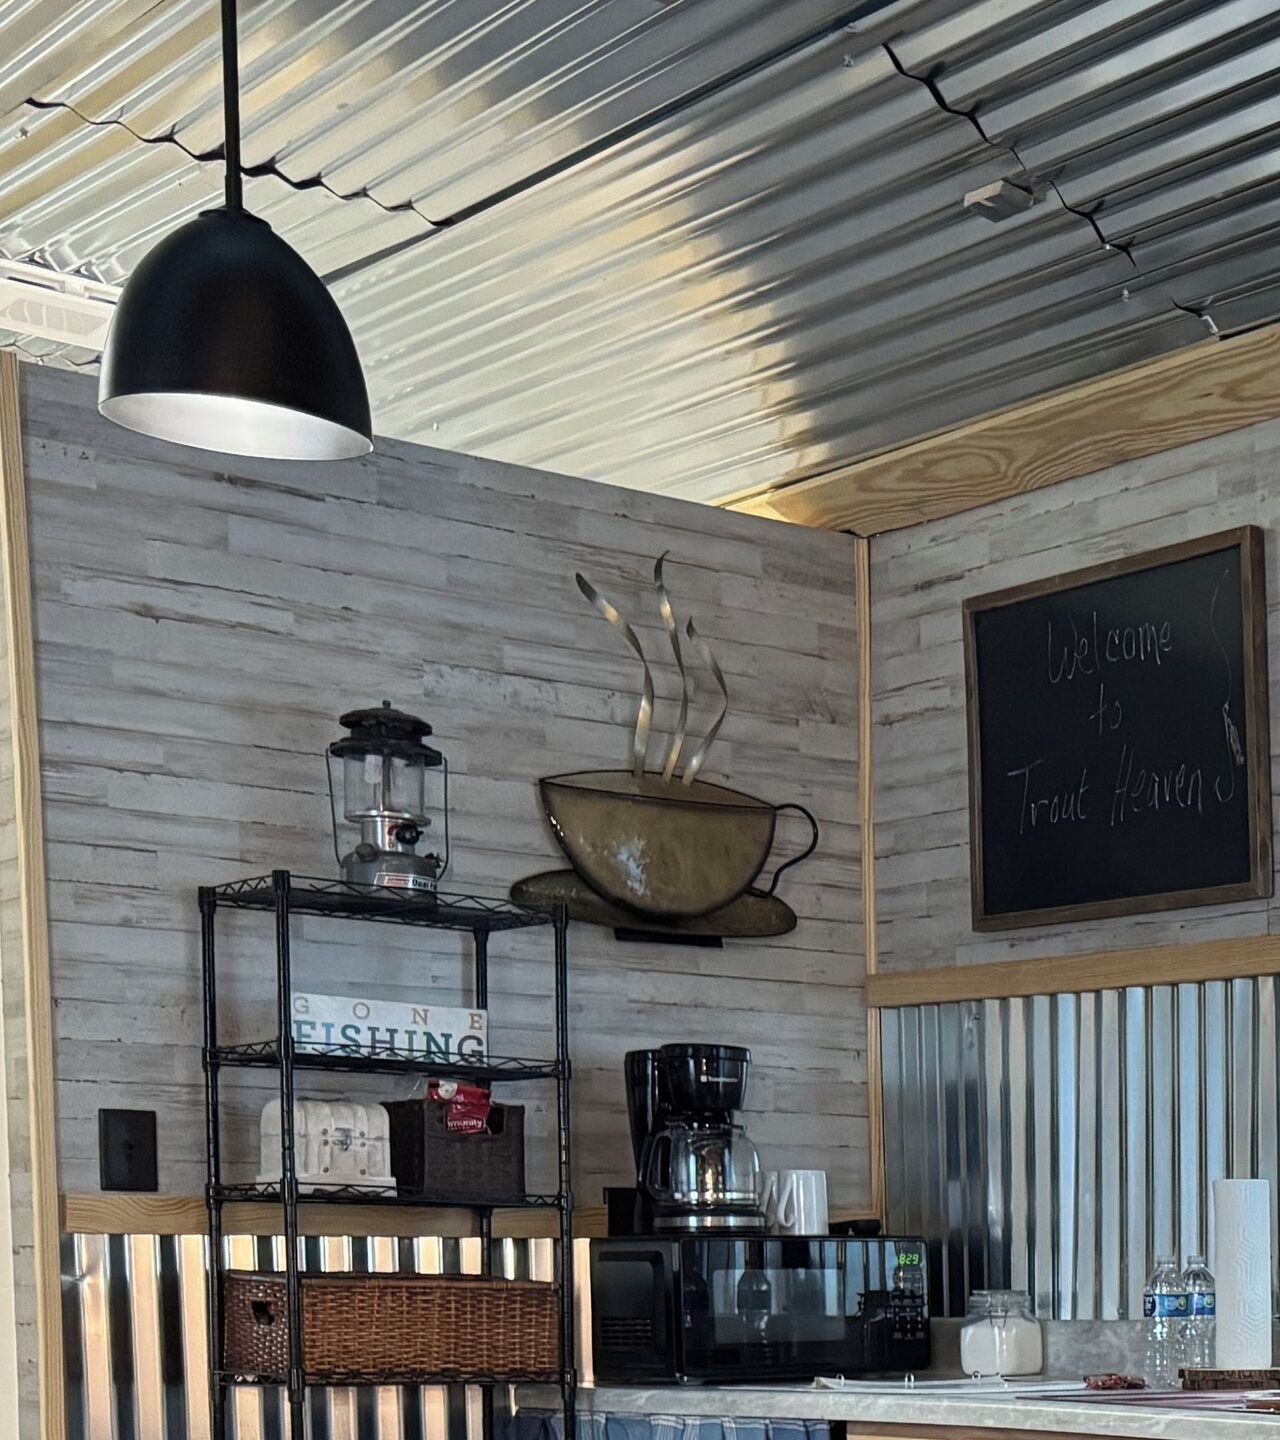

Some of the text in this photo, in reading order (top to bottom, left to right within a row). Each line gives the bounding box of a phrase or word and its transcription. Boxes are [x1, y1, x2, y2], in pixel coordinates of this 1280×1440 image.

[1048, 611, 1173, 684] Welcome
[1089, 683, 1123, 735] to
[1007, 744, 1202, 835] Trout Heaven
[293, 1019, 484, 1066] FISHING
